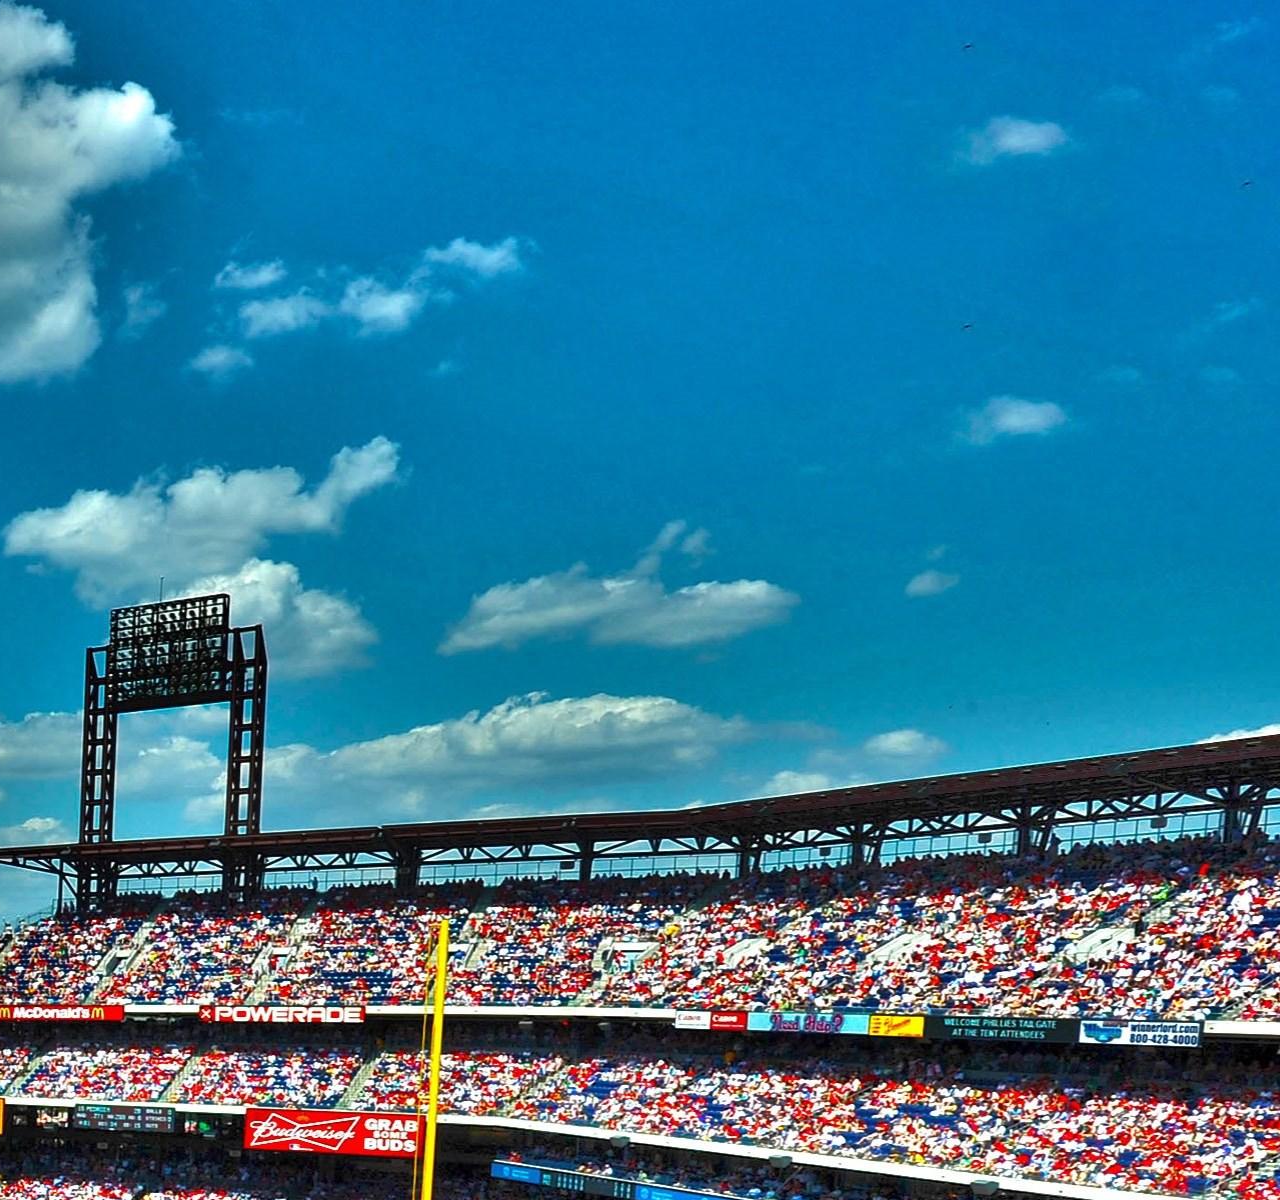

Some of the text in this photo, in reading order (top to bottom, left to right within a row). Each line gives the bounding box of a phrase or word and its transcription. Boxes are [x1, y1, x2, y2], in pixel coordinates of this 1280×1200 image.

[13, 1006, 90, 1019] McDonald's
[213, 1007, 362, 1022] POWERADE
[712, 1014, 737, 1023] Canon
[1129, 1033, 1199, 1046] 800-428-4000
[250, 1121, 354, 1141] Budweiser
[364, 1118, 418, 1132] GRAB
[373, 1131, 408, 1139] SOME
[363, 1138, 417, 1152] BUDS
